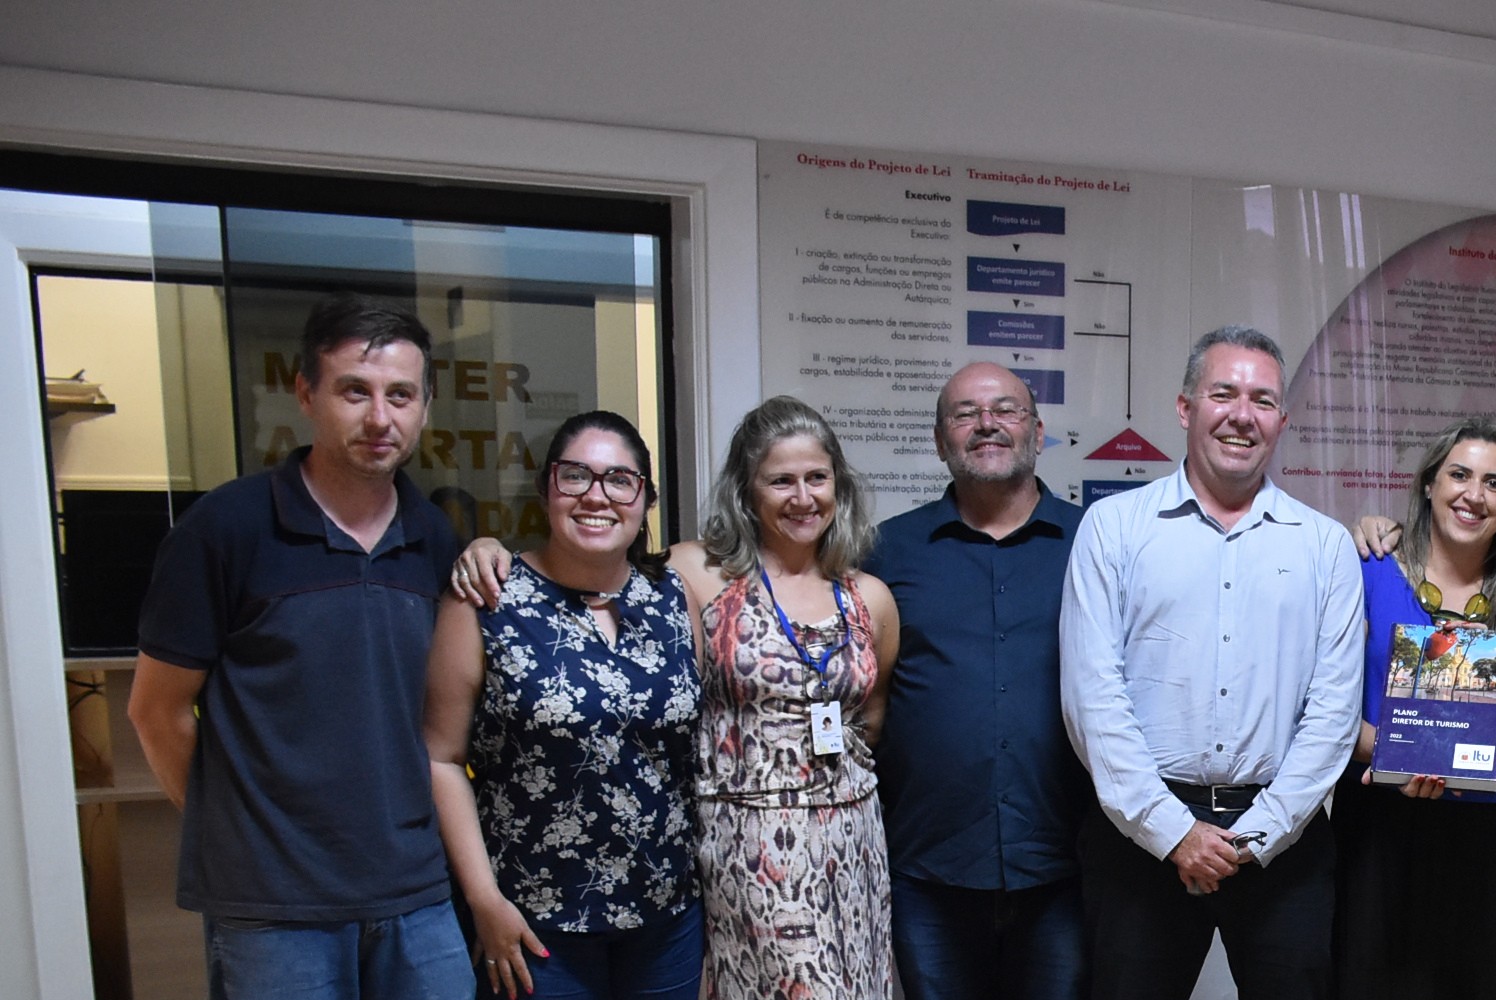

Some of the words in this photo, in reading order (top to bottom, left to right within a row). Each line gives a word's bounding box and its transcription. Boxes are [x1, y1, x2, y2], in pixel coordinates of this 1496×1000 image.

[797, 153, 846, 169] Origens
[849, 158, 865, 170] do
[868, 160, 912, 175] Projeto
[914, 164, 929, 176] de
[932, 165, 951, 177] Lei
[967, 168, 1034, 185] Tramitação
[1037, 174, 1051, 185] do
[1054, 176, 1094, 191] Projeto
[1097, 180, 1110, 191] de
[1113, 181, 1131, 192] Lei
[905, 189, 951, 202] Executivo
[825, 208, 831, 219] É
[833, 210, 844, 220] de
[846, 212, 899, 224] competência
[901, 217, 938, 228] exclusiva
[940, 218, 951, 228] do
[992, 214, 1019, 227] Projeto
[1020, 217, 1029, 225] de
[1030, 218, 1041, 226] Lei
[843, 251, 879, 262] extinção
[893, 254, 952, 267] transformação
[1449, 246, 1486, 259] Instituto
[818, 262, 829, 271] de
[865, 264, 897, 277] funções
[899, 269, 910, 277] ou
[912, 269, 952, 281] empregos
[976, 264, 1028, 277] Departamento
[802, 275, 838, 285] públicos
[839, 278, 850, 286] na
[853, 277, 912, 290] Administração
[914, 281, 939, 291] Direta
[941, 284, 952, 292] ou
[801, 313, 833, 325] fixação
[848, 317, 884, 326] aumento
[886, 317, 897, 327] de
[899, 320, 952, 331] remuneração
[891, 331, 906, 340] dos
[827, 355, 856, 366] regime
[894, 357, 940, 368] provimento
[941, 358, 952, 368] de
[833, 368, 884, 378] estabilidade
[893, 370, 952, 380] aposentadoria
[891, 382, 907, 391] dos
[823, 406, 832, 415] IV
[839, 407, 892, 419] organização
[893, 408, 936, 418] administra
[849, 419, 887, 429] tributária
[896, 422, 936, 431] orçament
[865, 433, 899, 444] públicos
[1115, 443, 1142, 452] Arquivo
[1388, 470, 1414, 479] docum
[1393, 708, 1418, 717] PLANO
[1392, 717, 1423, 726] DIRETOR
[1424, 719, 1434, 727] DE
[1436, 720, 1470, 729] TURISMO
[1473, 750, 1491, 762] Itu
